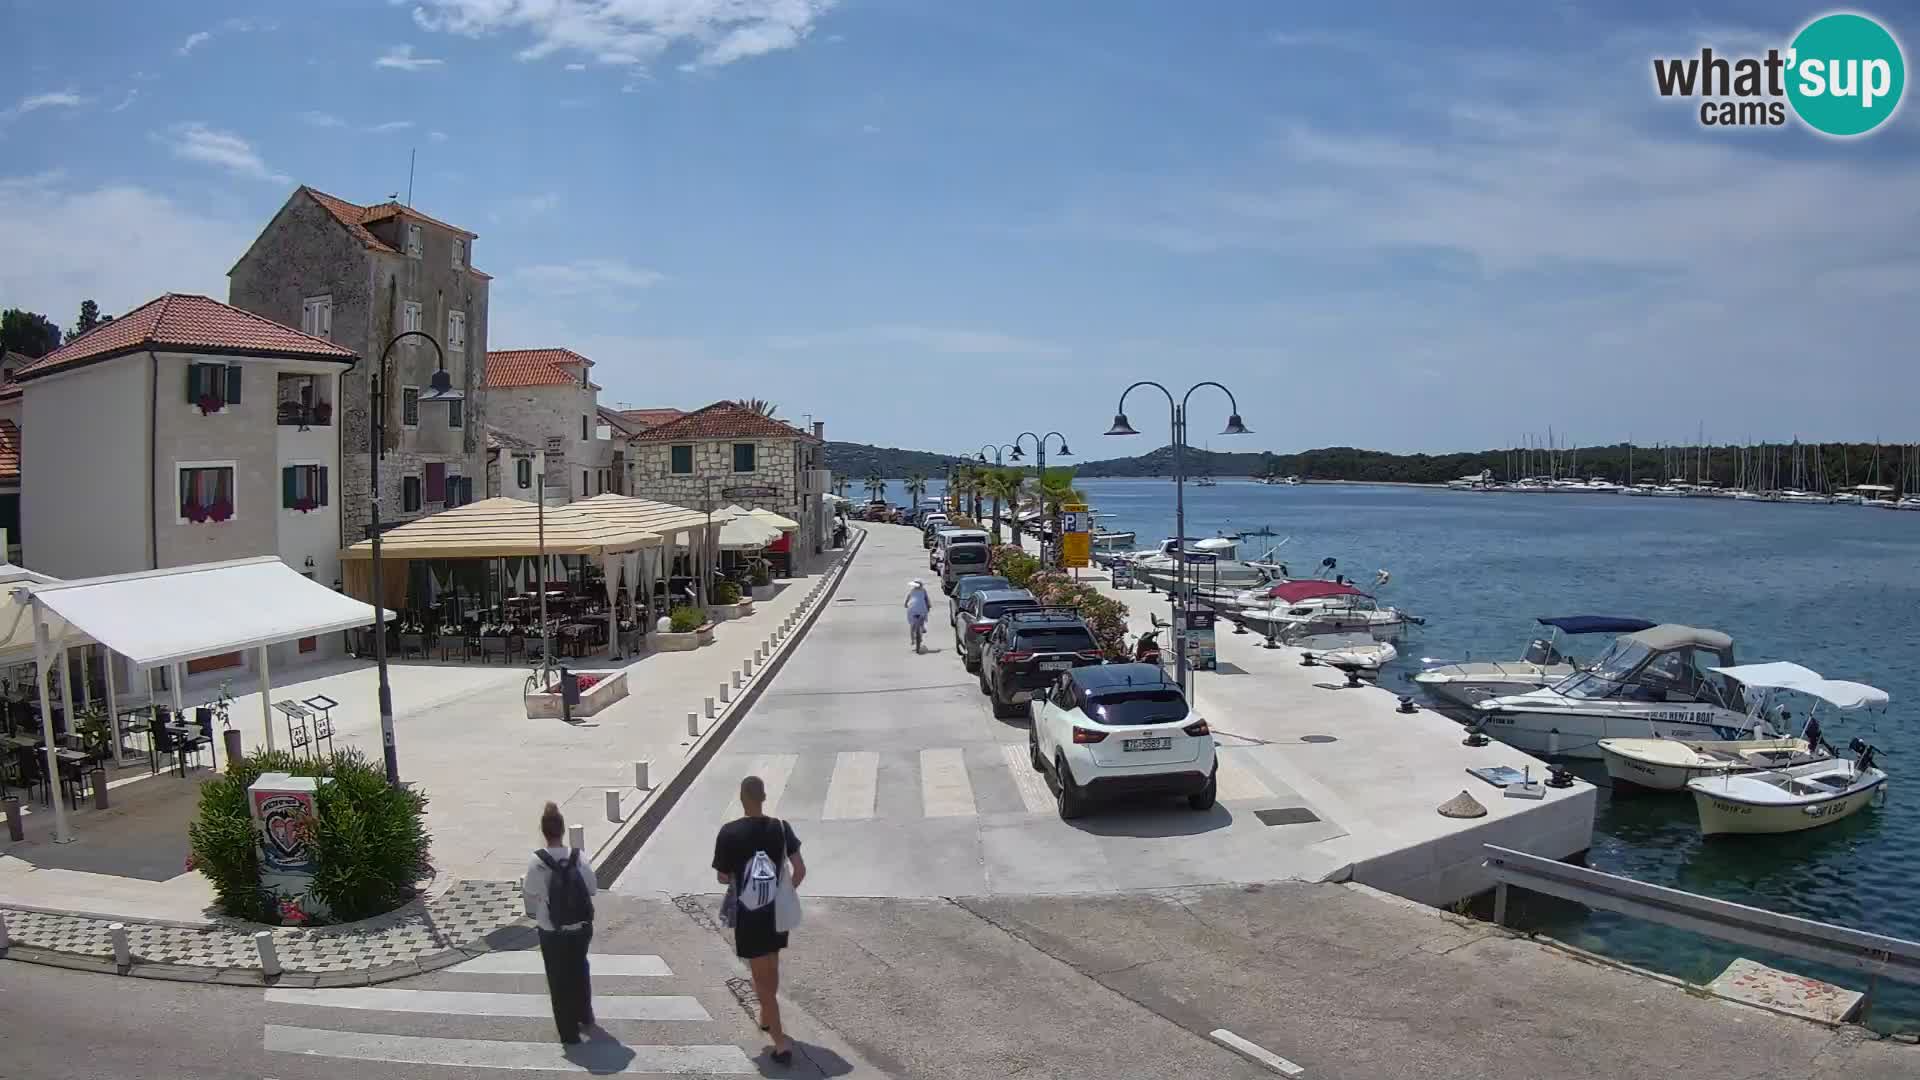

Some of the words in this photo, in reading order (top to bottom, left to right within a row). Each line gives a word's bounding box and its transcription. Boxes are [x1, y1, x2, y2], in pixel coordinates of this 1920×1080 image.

[1065, 514, 1076, 530] P
[1669, 711, 1689, 721] RENT
[1696, 712, 1715, 723] BOAT
